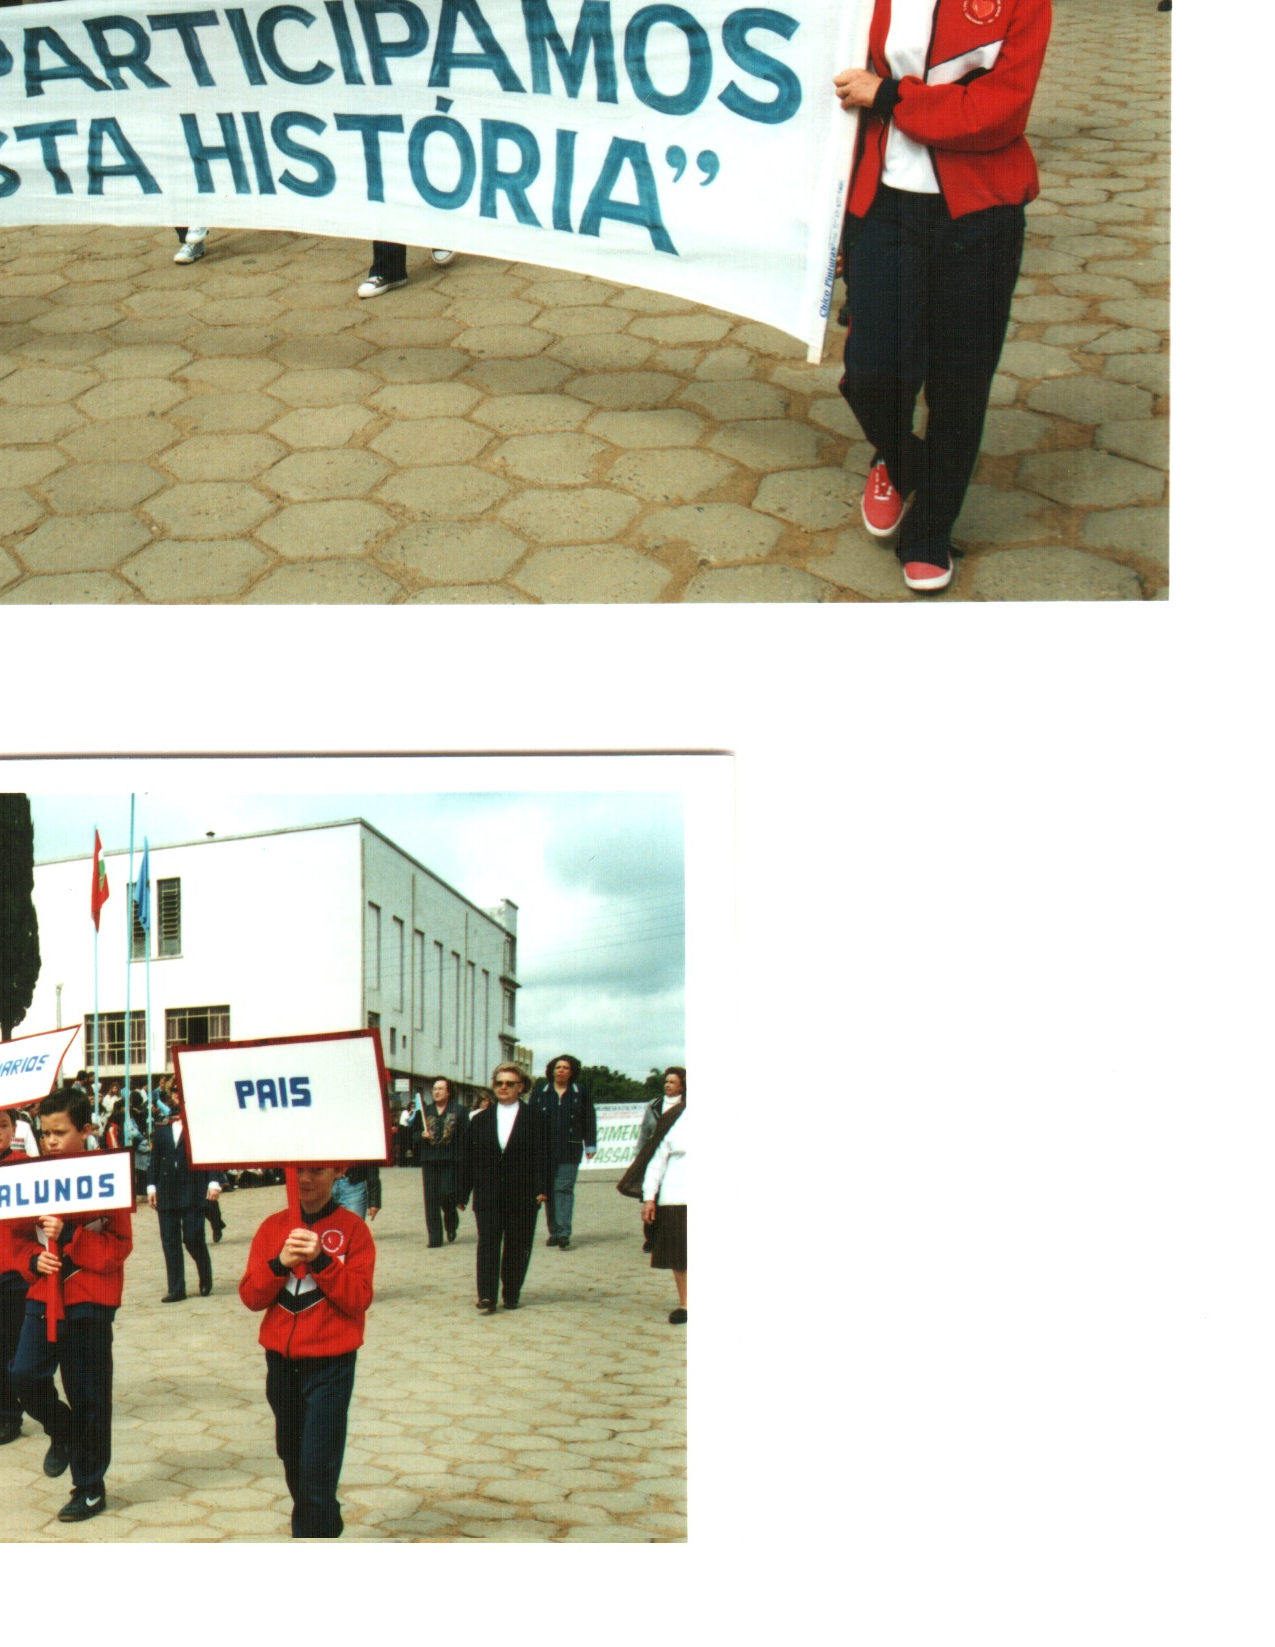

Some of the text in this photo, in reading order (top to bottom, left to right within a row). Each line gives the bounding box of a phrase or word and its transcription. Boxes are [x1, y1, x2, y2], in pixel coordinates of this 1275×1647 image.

[180, 95, 721, 257] HISTÓRIA"
[823, 246, 838, 287] Pinturas
[819, 289, 830, 318] Chico
[234, 1076, 312, 1109] PAIS
